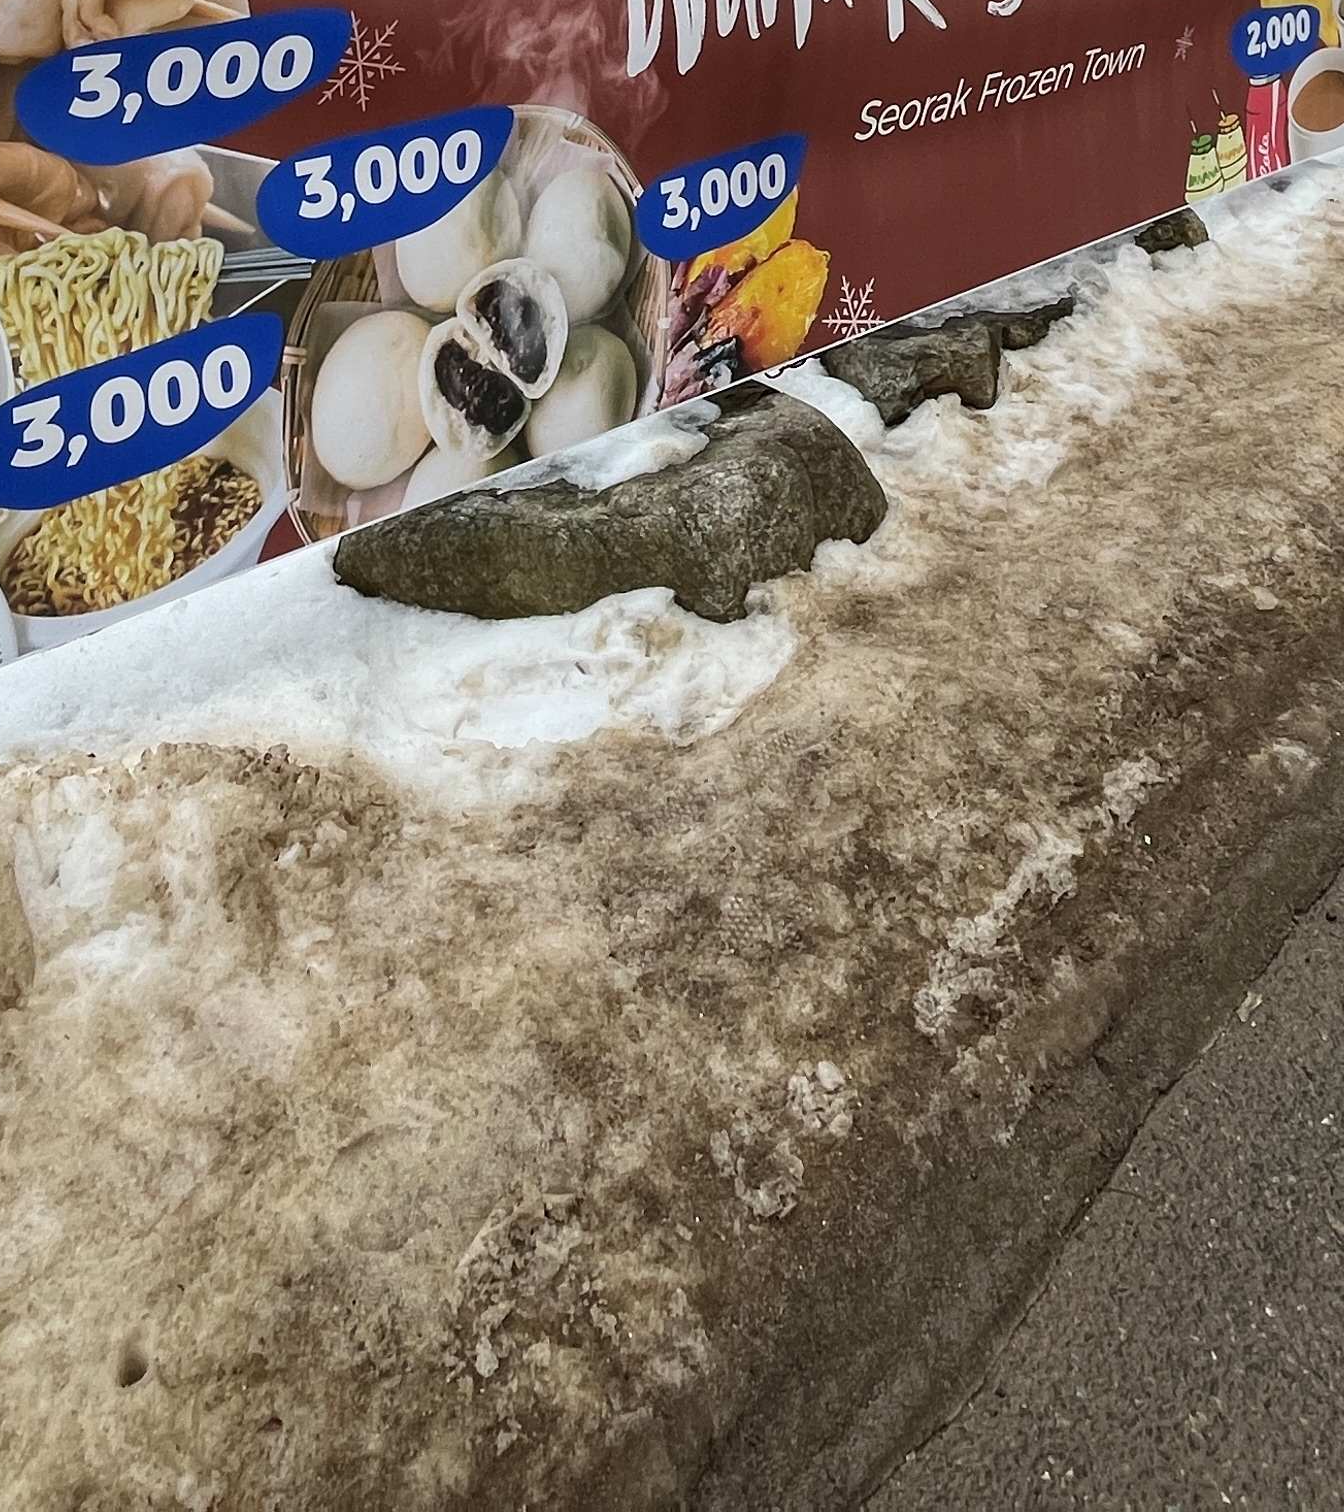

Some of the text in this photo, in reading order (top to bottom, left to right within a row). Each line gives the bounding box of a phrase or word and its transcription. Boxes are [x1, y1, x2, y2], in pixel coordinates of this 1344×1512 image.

[67, 34, 316, 125] 3,000
[1246, 9, 1311, 58] 2,000
[854, 41, 1147, 142] Seorak Frozen Town
[294, 129, 483, 223] 3,000
[660, 152, 788, 233] 3,000
[10, 344, 252, 469] 3,000
